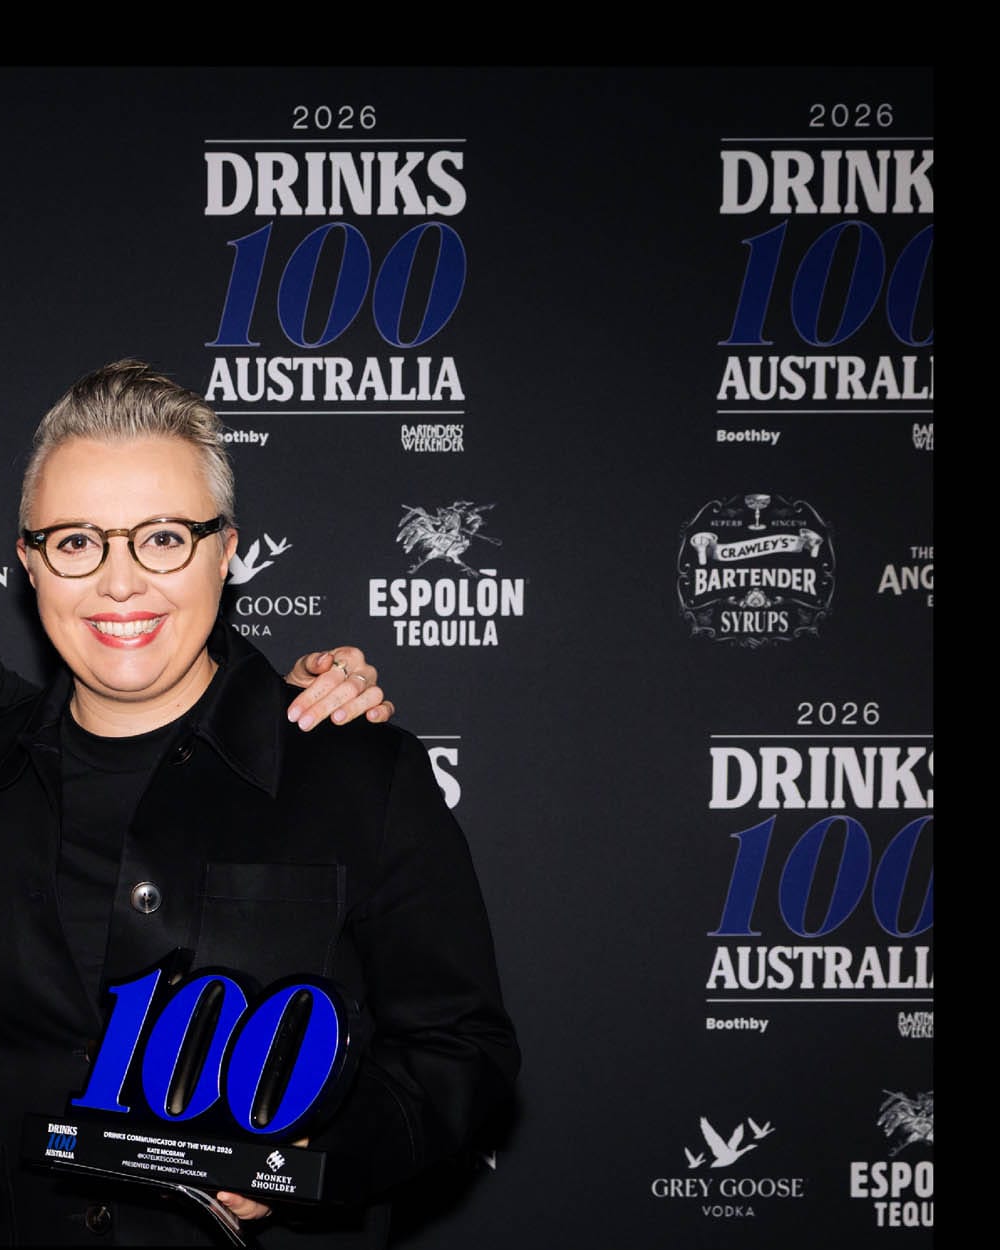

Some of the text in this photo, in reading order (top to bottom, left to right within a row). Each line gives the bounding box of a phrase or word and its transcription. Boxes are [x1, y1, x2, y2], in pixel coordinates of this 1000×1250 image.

[293, 106, 376, 129] 2026
[809, 104, 893, 127] 2026
[205, 151, 466, 216] DRINKS
[720, 150, 933, 214] DRINK
[204, 220, 467, 349] 100
[205, 357, 465, 401] AUSTRALIA
[717, 356, 933, 400] AUSTRAL
[401, 437, 464, 451] WEEKENDER
[717, 430, 780, 445] Boothby
[695, 568, 817, 595] BARTENDER
[236, 596, 321, 615] GOOSE
[232, 624, 271, 636] DKA
[394, 620, 498, 646] TEQUILA
[721, 611, 788, 632] SYRUPS
[798, 702, 879, 725] 2026
[709, 747, 933, 809] DRINK
[706, 946, 933, 989] AUSTRALI
[706, 1018, 768, 1032] Boothby
[72, 969, 339, 1135] 100
[48, 1123, 78, 1136] DRINKS
[104, 1131, 126, 1140] DRINKS
[126, 1134, 176, 1147] COMMUNICATOR
[187, 1142, 199, 1150] THE
[200, 1144, 216, 1153] YEAR
[45, 1149, 74, 1159] AUSTRALIA
[122, 1160, 150, 1170] PRESENTED
[158, 1165, 179, 1175] MONKEY
[179, 1168, 208, 1178] SHOULDER
[256, 1171, 292, 1185] MONKEY
[851, 1161, 933, 1198] ESPO
[251, 1180, 296, 1193] SHOULDER
[652, 1179, 803, 1197] GREY GOOSE
[702, 1206, 754, 1217] VODKA
[875, 1202, 933, 1226] TEQU
